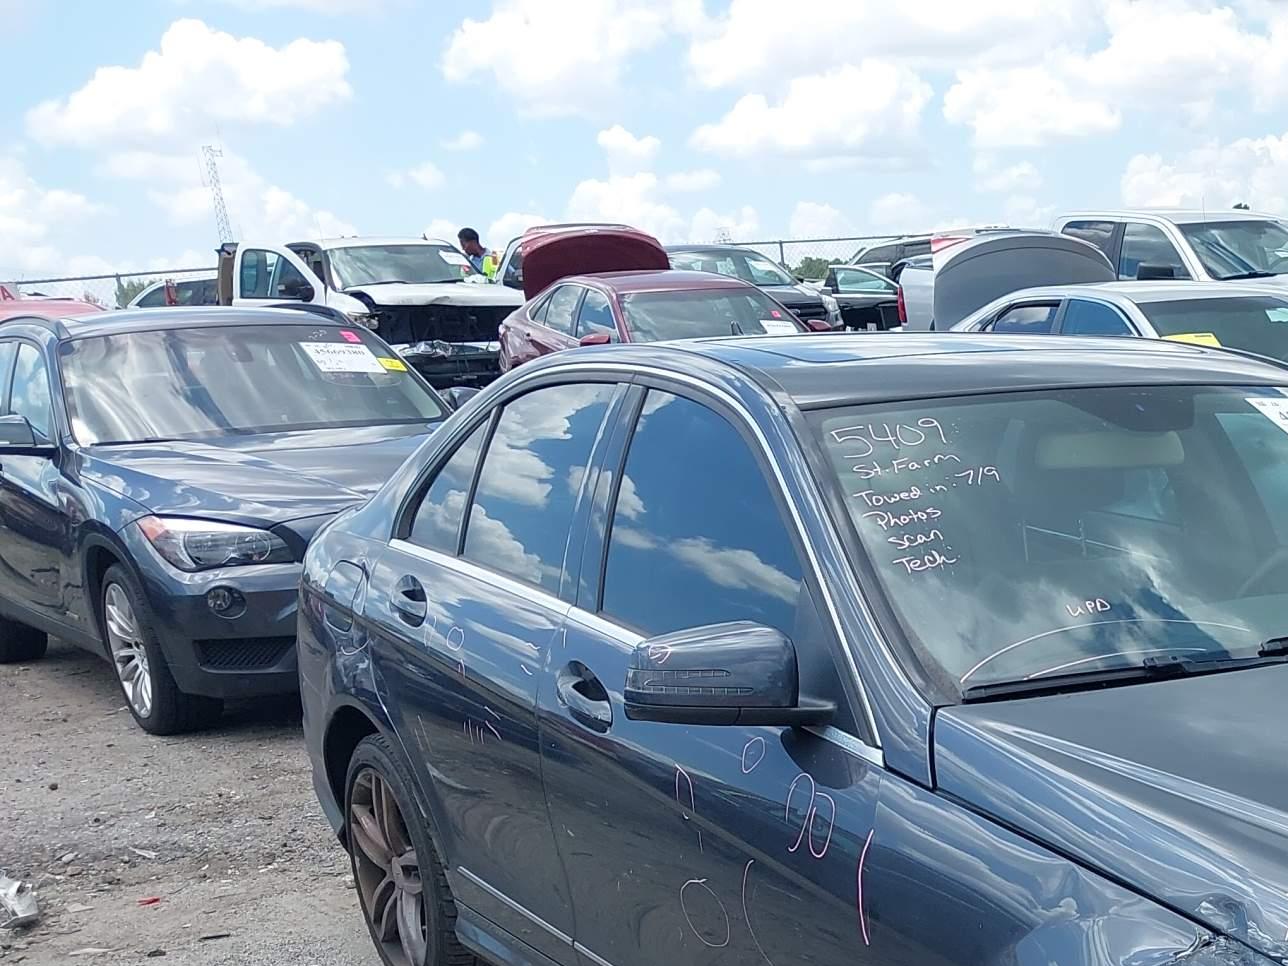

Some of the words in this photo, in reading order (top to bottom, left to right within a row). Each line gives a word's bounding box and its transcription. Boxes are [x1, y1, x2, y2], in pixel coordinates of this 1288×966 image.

[830, 418, 947, 458] 5409
[853, 486, 923, 507] Towed
[862, 507, 942, 531] Photos
